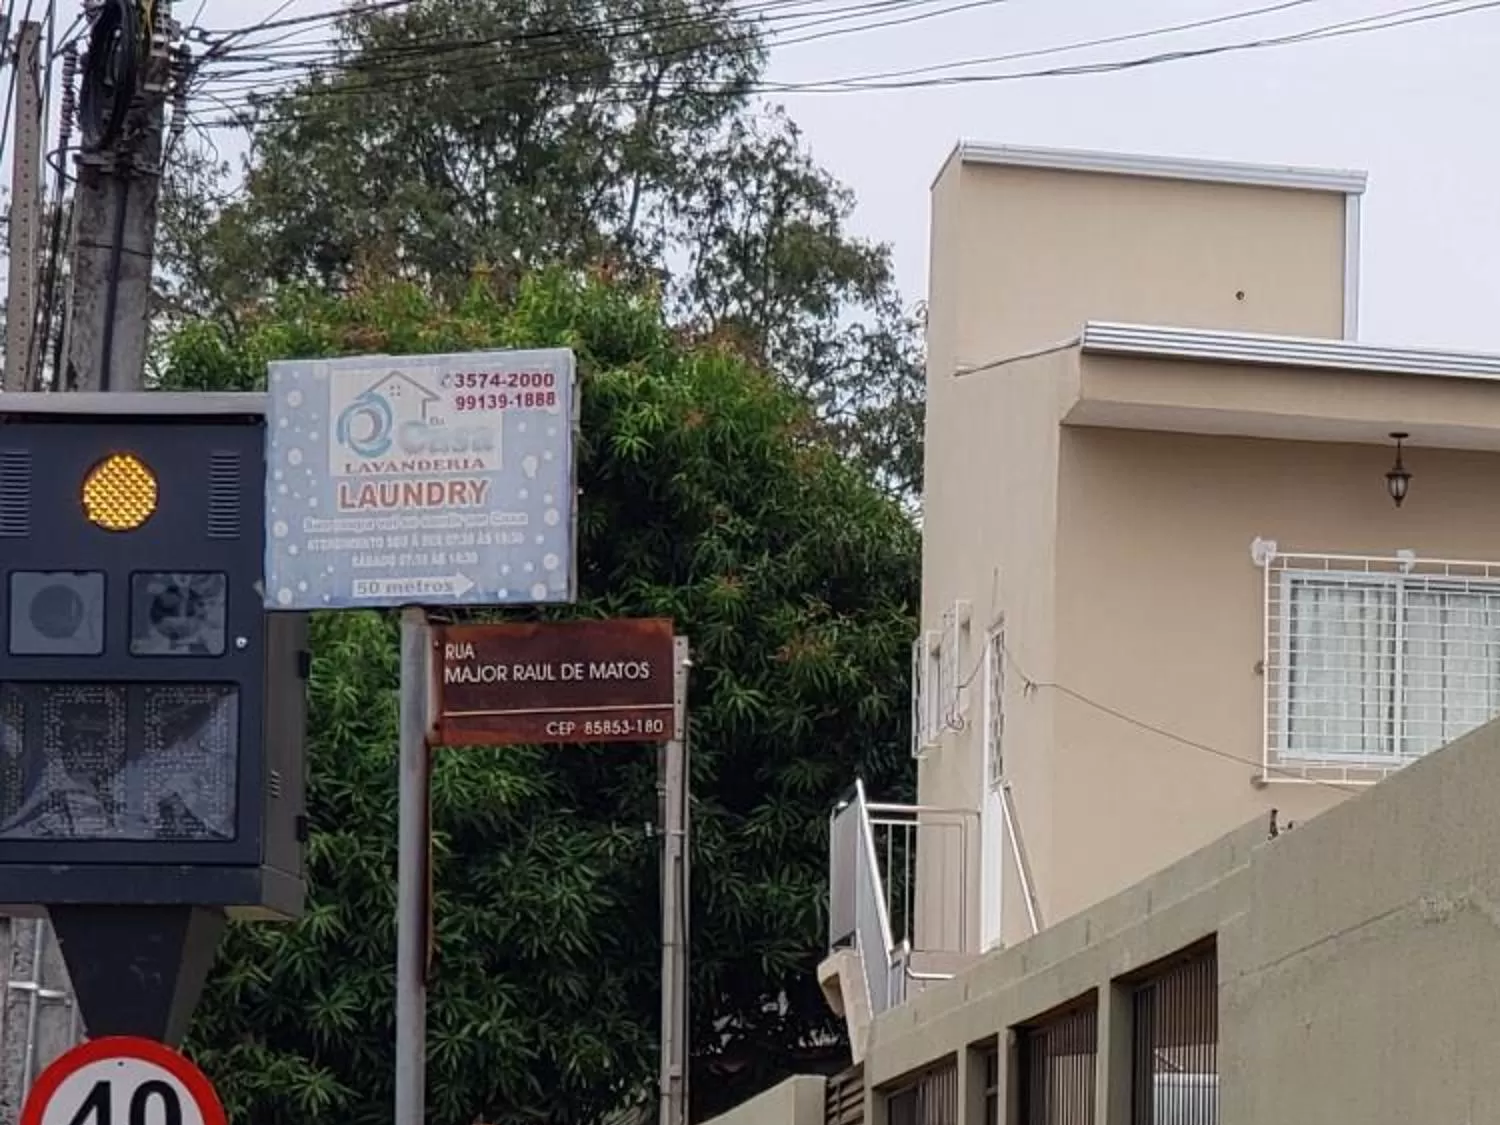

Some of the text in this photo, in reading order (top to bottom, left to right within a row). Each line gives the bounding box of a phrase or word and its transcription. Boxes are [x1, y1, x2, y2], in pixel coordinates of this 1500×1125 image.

[453, 372, 556, 389] 3574-2000
[345, 458, 485, 475] LAVANDERIA
[339, 479, 488, 510] LAUNDRY
[357, 581, 379, 594] 50
[445, 643, 475, 660] RUA
[444, 661, 651, 684] MAJOR RAUL DE MATOS
[546, 719, 664, 736] CEP 85853-180
